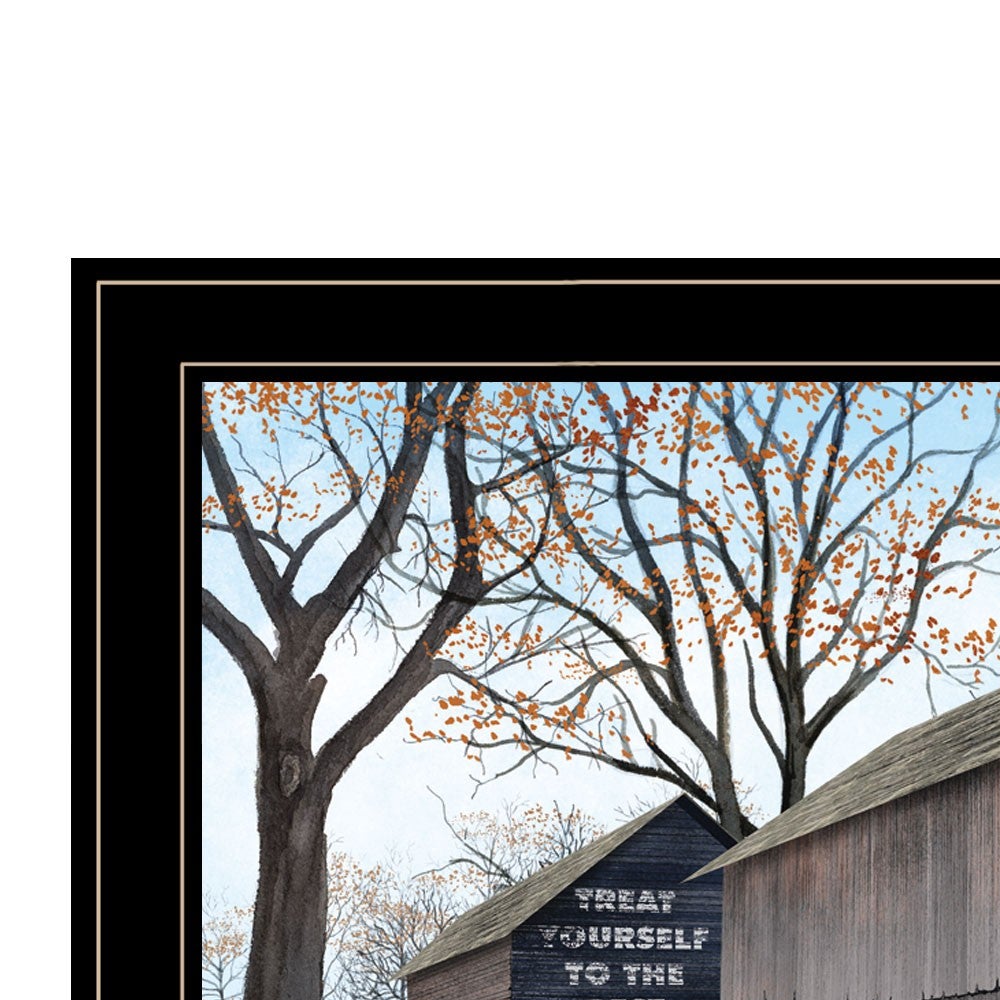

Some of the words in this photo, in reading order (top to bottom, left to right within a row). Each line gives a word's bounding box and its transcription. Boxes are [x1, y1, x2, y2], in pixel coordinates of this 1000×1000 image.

[575, 887, 676, 914] TREAT
[538, 925, 709, 950] YOURSELF
[564, 962, 610, 986] TO
[623, 962, 684, 986] THE
